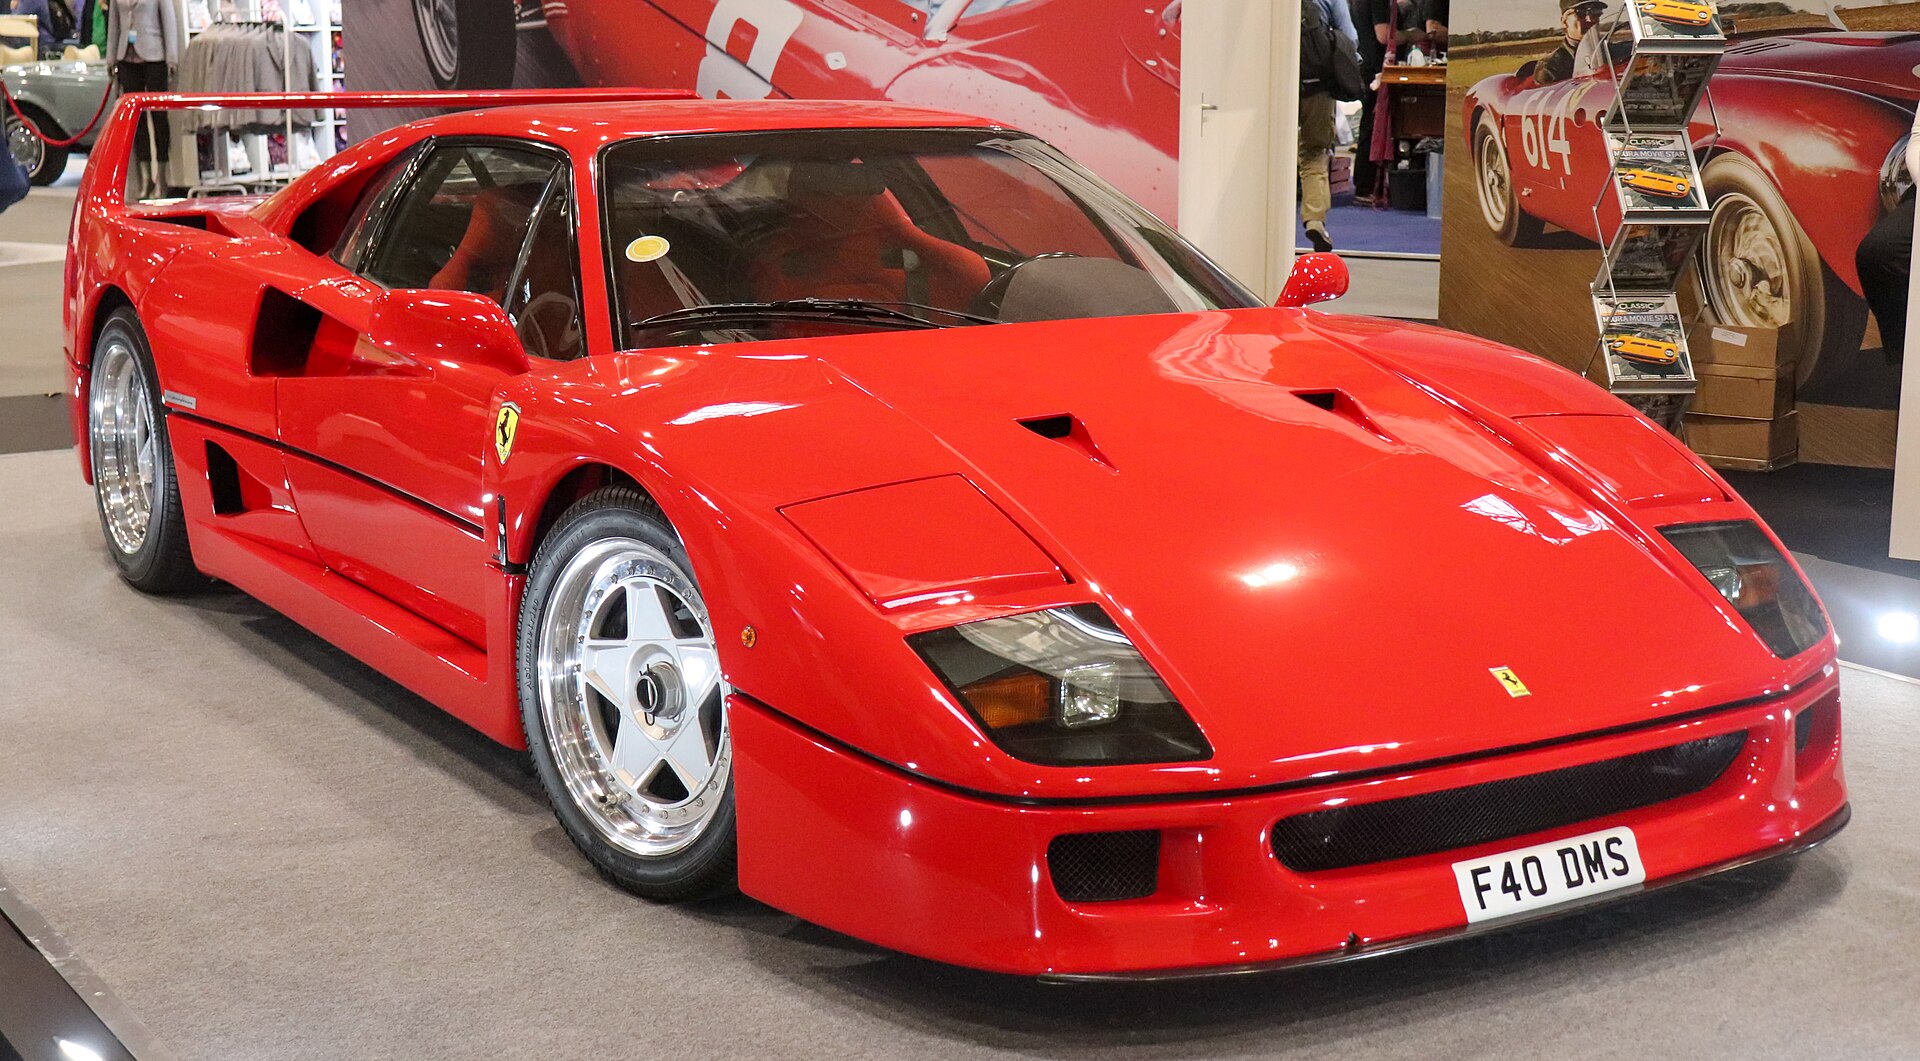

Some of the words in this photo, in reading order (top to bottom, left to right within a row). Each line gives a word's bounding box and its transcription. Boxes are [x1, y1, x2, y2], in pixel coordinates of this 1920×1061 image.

[1521, 88, 1575, 175] 614
[1629, 314, 1654, 322] MOVIE
[1470, 855, 1548, 910] F40
[1556, 836, 1630, 889] DMS
